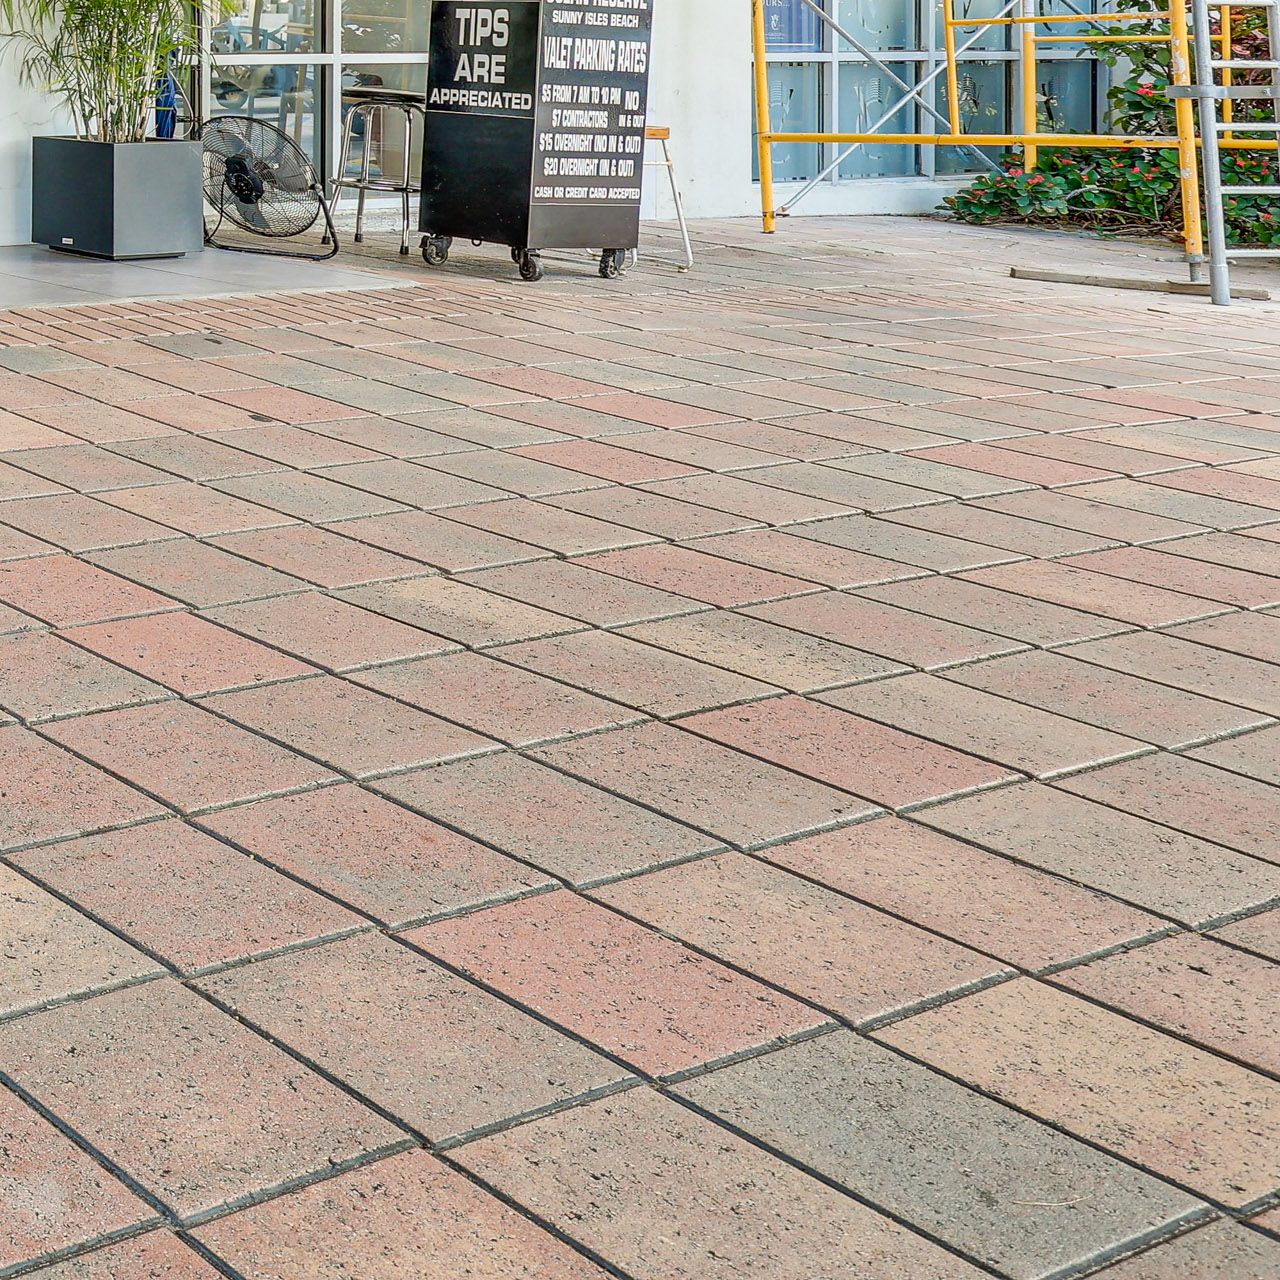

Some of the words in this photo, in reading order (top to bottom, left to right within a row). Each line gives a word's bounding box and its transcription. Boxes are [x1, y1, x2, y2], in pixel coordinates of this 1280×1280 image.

[455, 8, 509, 47] TIPS
[552, 10, 583, 25] SUNNY
[585, 12, 608, 26] ISLES
[610, 14, 639, 28] BEACH
[544, 36, 573, 69] VALET
[573, 38, 616, 72] PARKING
[617, 40, 647, 74] RATES
[453, 53, 506, 84] ARE
[429, 87, 532, 110] APPRECIATED
[542, 84, 551, 103] $5
[552, 84, 572, 103] FROM
[572, 85, 578, 103] 7
[578, 85, 590, 104] AM
[591, 86, 600, 104] TO
[601, 87, 609, 104] 10
[610, 87, 621, 105] PM
[625, 91, 639, 110] NO
[552, 109, 561, 128] $7
[562, 109, 608, 128] CONTRACTORS
[618, 114, 626, 127] IN
[627, 115, 632, 127] &
[632, 115, 645, 127] OUT
[539, 133, 553, 151] $15
[554, 133, 593, 152] OVERNIGHT
[608, 135, 617, 153] IN
[618, 135, 623, 153] &
[543, 157, 558, 176] $20
[559, 158, 598, 176] OVERNIGHT
[611, 159, 617, 177] &
[534, 187, 552, 198] CASH
[554, 187, 564, 198] OR
[565, 187, 589, 199] CREDIT
[589, 187, 607, 199] CARD
[608, 188, 640, 200] ACCEPTED
